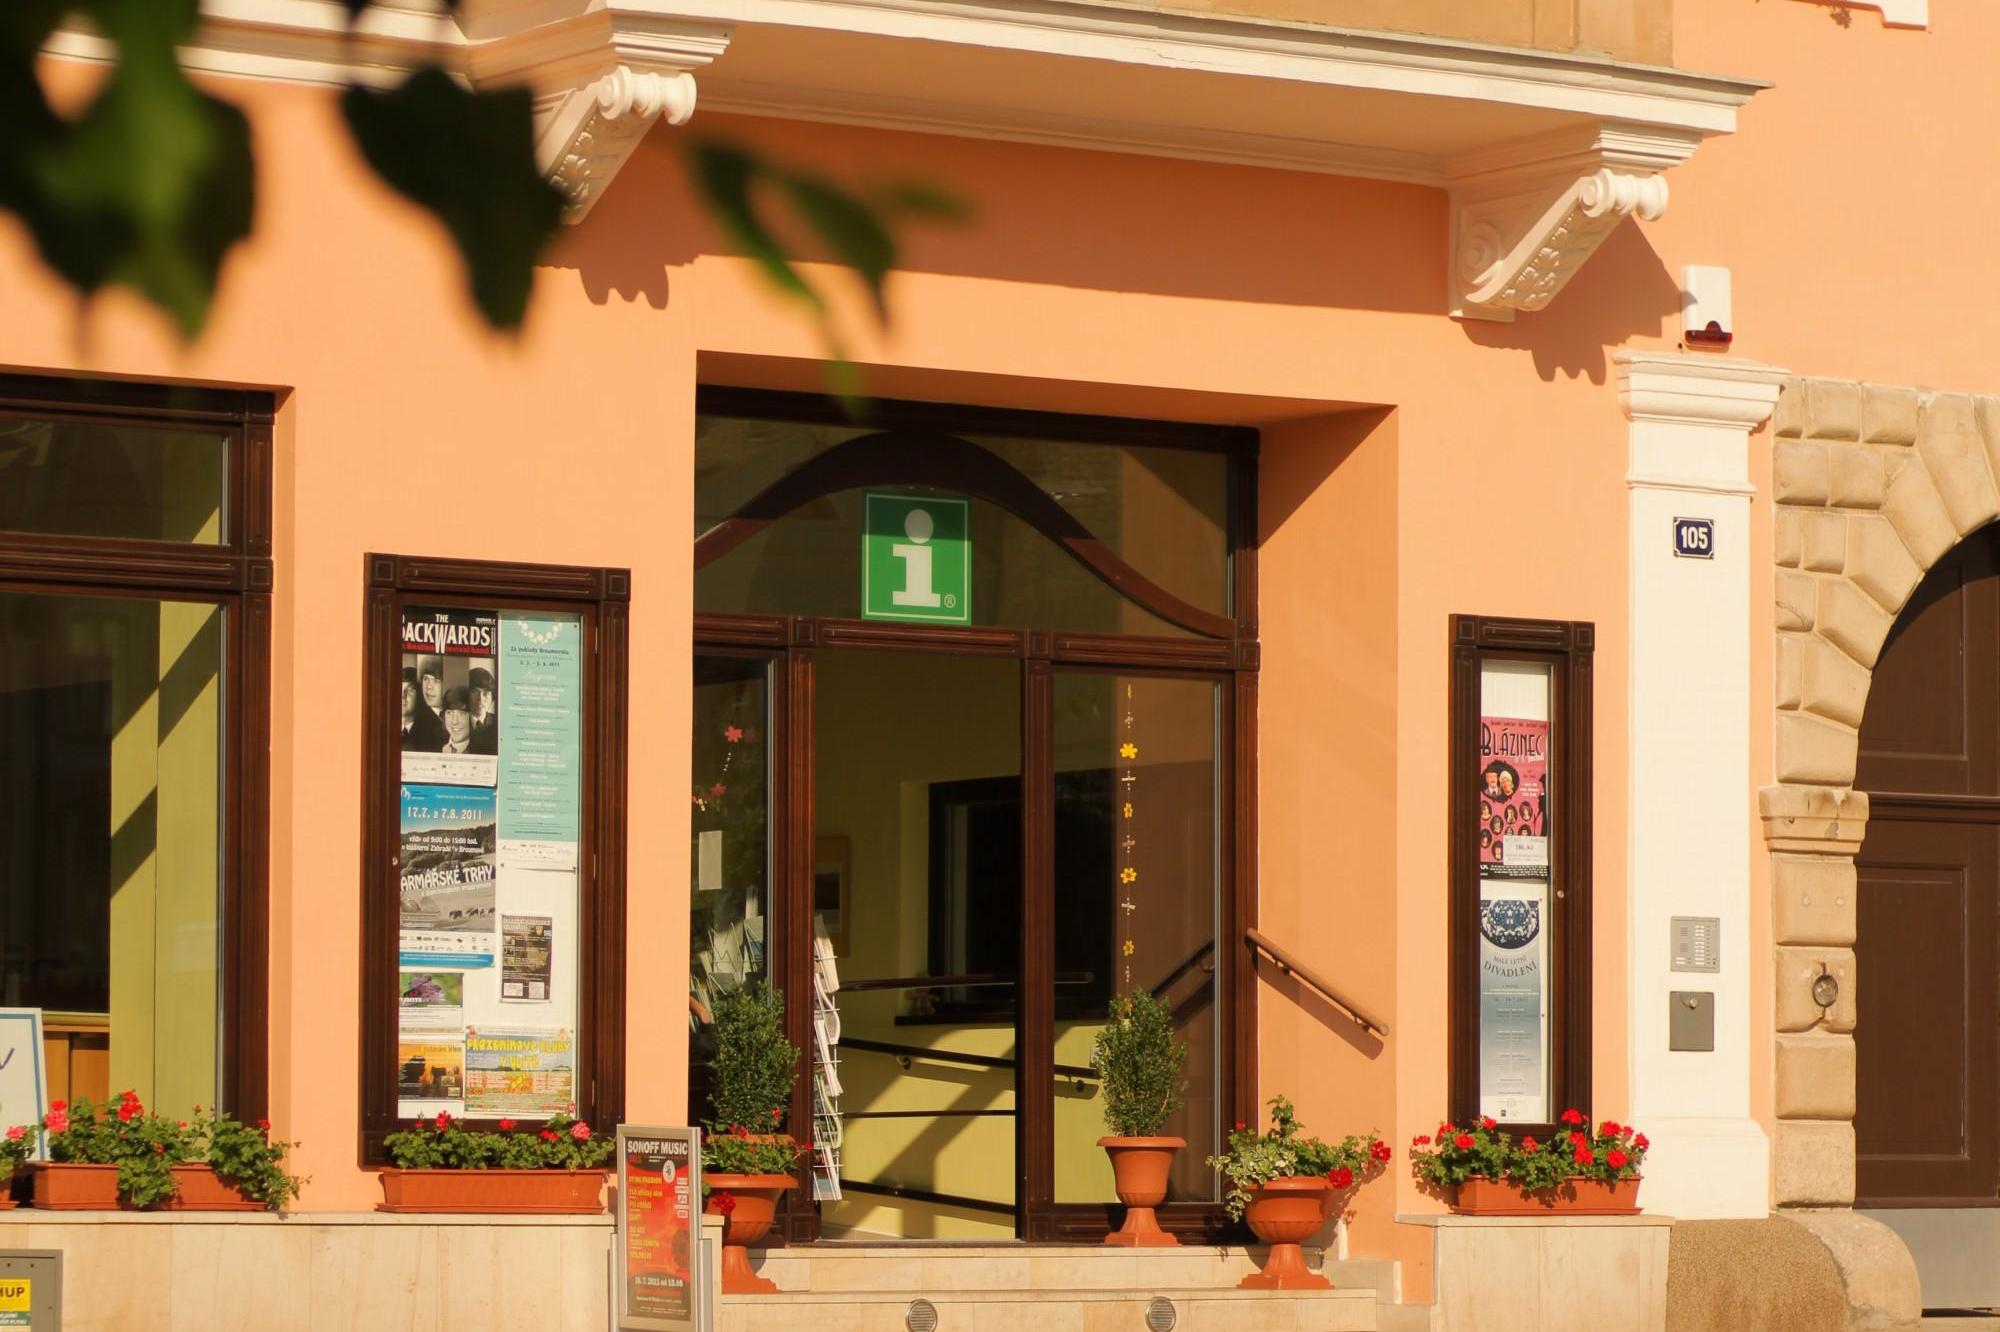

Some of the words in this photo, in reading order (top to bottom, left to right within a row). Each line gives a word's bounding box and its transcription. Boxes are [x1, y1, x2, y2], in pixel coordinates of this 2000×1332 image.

[1681, 526, 1708, 549] 105
[435, 613, 449, 623] THE
[1481, 722, 1541, 757] BLÁZINEC
[461, 809, 482, 820] 2011
[462, 864, 493, 883] TRHY
[1484, 959, 1537, 977] DIVADLENÍ
[627, 1140, 660, 1154] SONOFF
[660, 1141, 688, 1156] MUSIC
